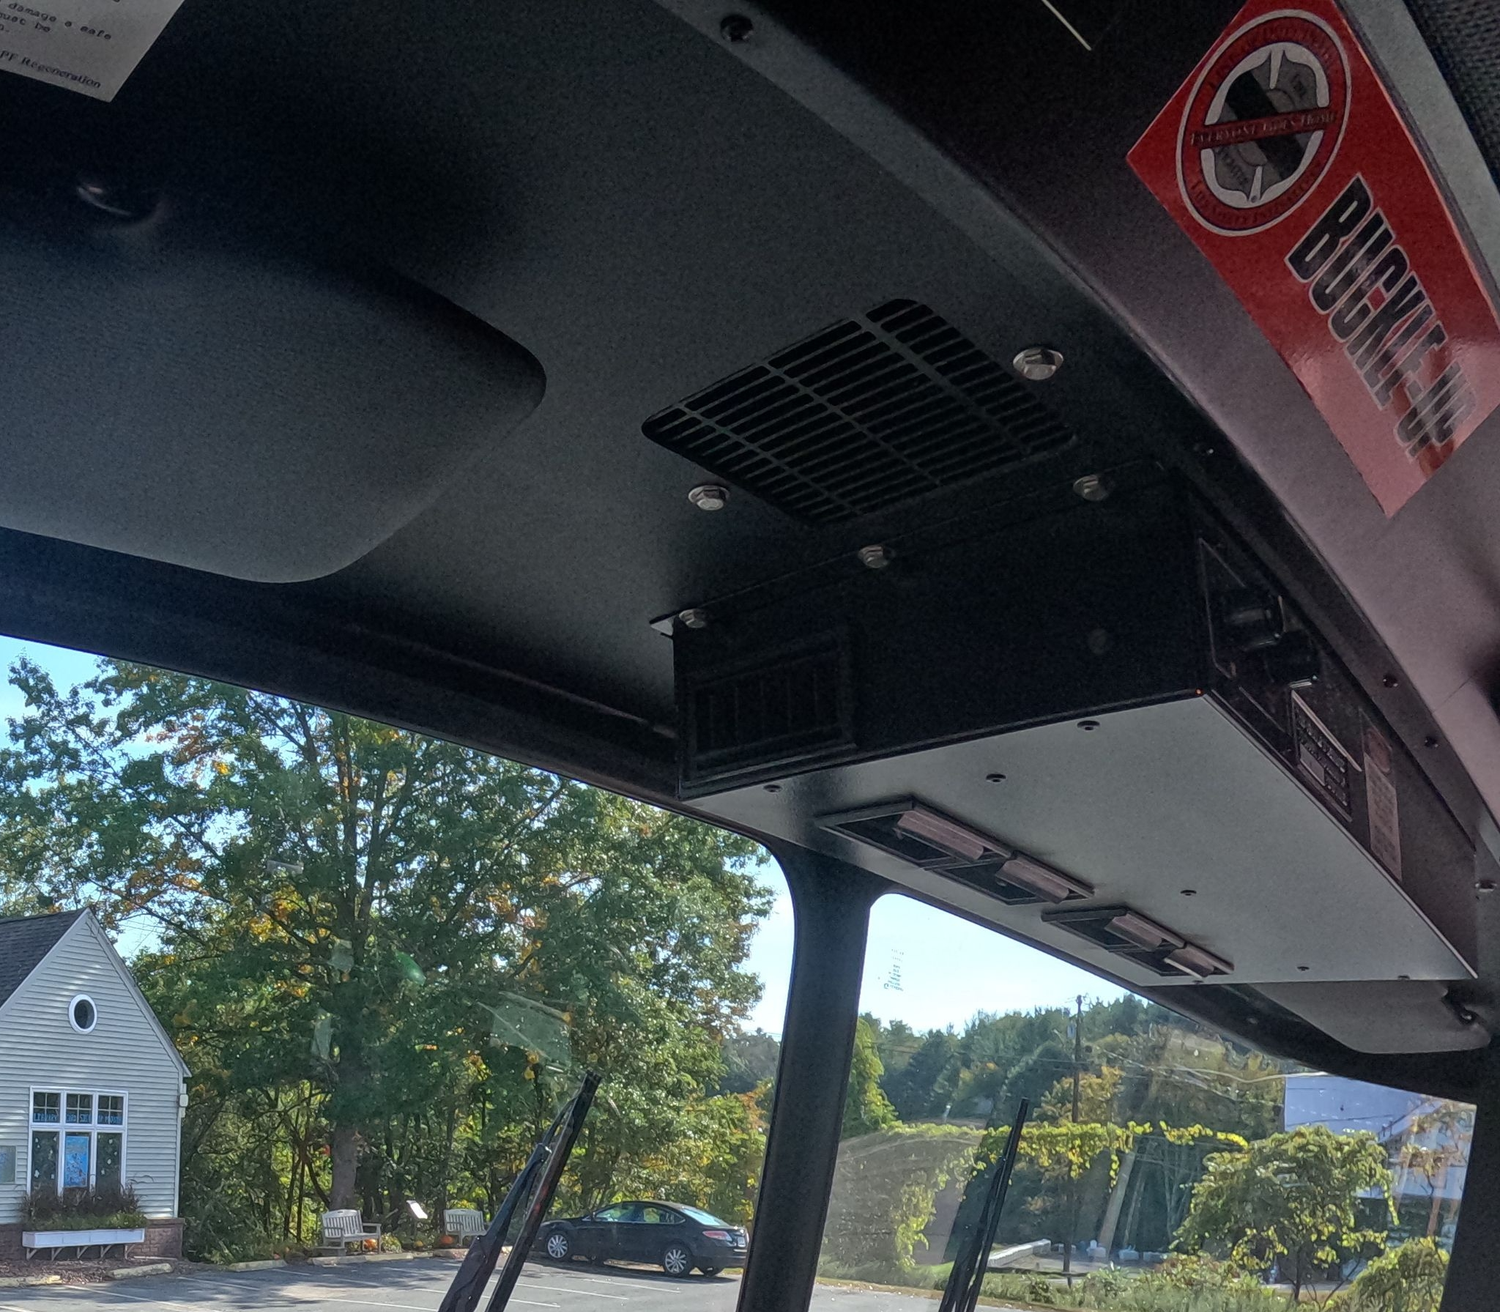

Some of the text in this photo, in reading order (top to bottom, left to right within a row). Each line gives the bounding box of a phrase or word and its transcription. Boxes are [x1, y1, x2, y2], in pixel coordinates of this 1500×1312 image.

[9, 2, 57, 22] damage
[80, 25, 112, 40] safe
[35, 22, 51, 33] be
[21, 56, 102, 88] Regeneration
